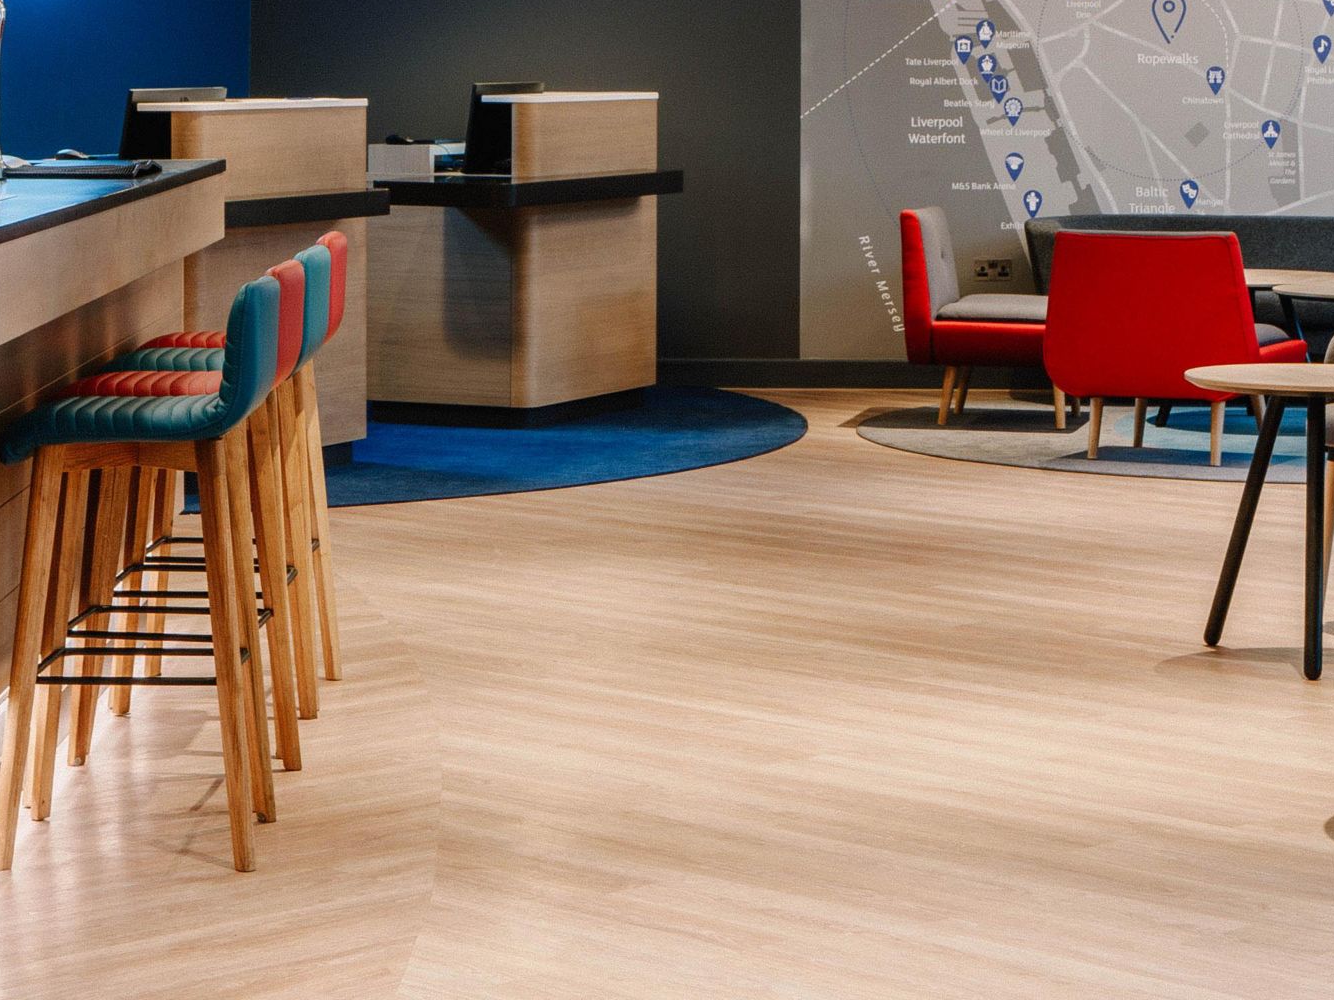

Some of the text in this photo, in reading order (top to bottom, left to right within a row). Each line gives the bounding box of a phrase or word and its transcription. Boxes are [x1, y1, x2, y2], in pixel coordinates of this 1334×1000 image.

[1067, 0, 1101, 9] Liverpool
[996, 29, 1030, 38] Maritime
[996, 41, 1030, 49] Museum
[905, 57, 958, 68] Tate Liverpool
[1137, 53, 1199, 67] Ropewalks
[1304, 66, 1327, 75] Royal
[909, 77, 978, 86] Royal Albert Dock
[944, 99, 995, 110] Beatles Story
[1181, 97, 1224, 105] Chinatown
[911, 116, 963, 129] Liverpool
[1224, 121, 1259, 131] Liverpool
[908, 132, 966, 144] Waterfont
[980, 128, 1050, 138] Wheel of Liverpool
[1223, 131, 1260, 140] Cathedral
[952, 182, 1016, 190] M&S Bank Arena
[1136, 186, 1169, 198] Baltic
[1129, 203, 1176, 215] Triangle
[858, 234, 906, 333] River Mersey
